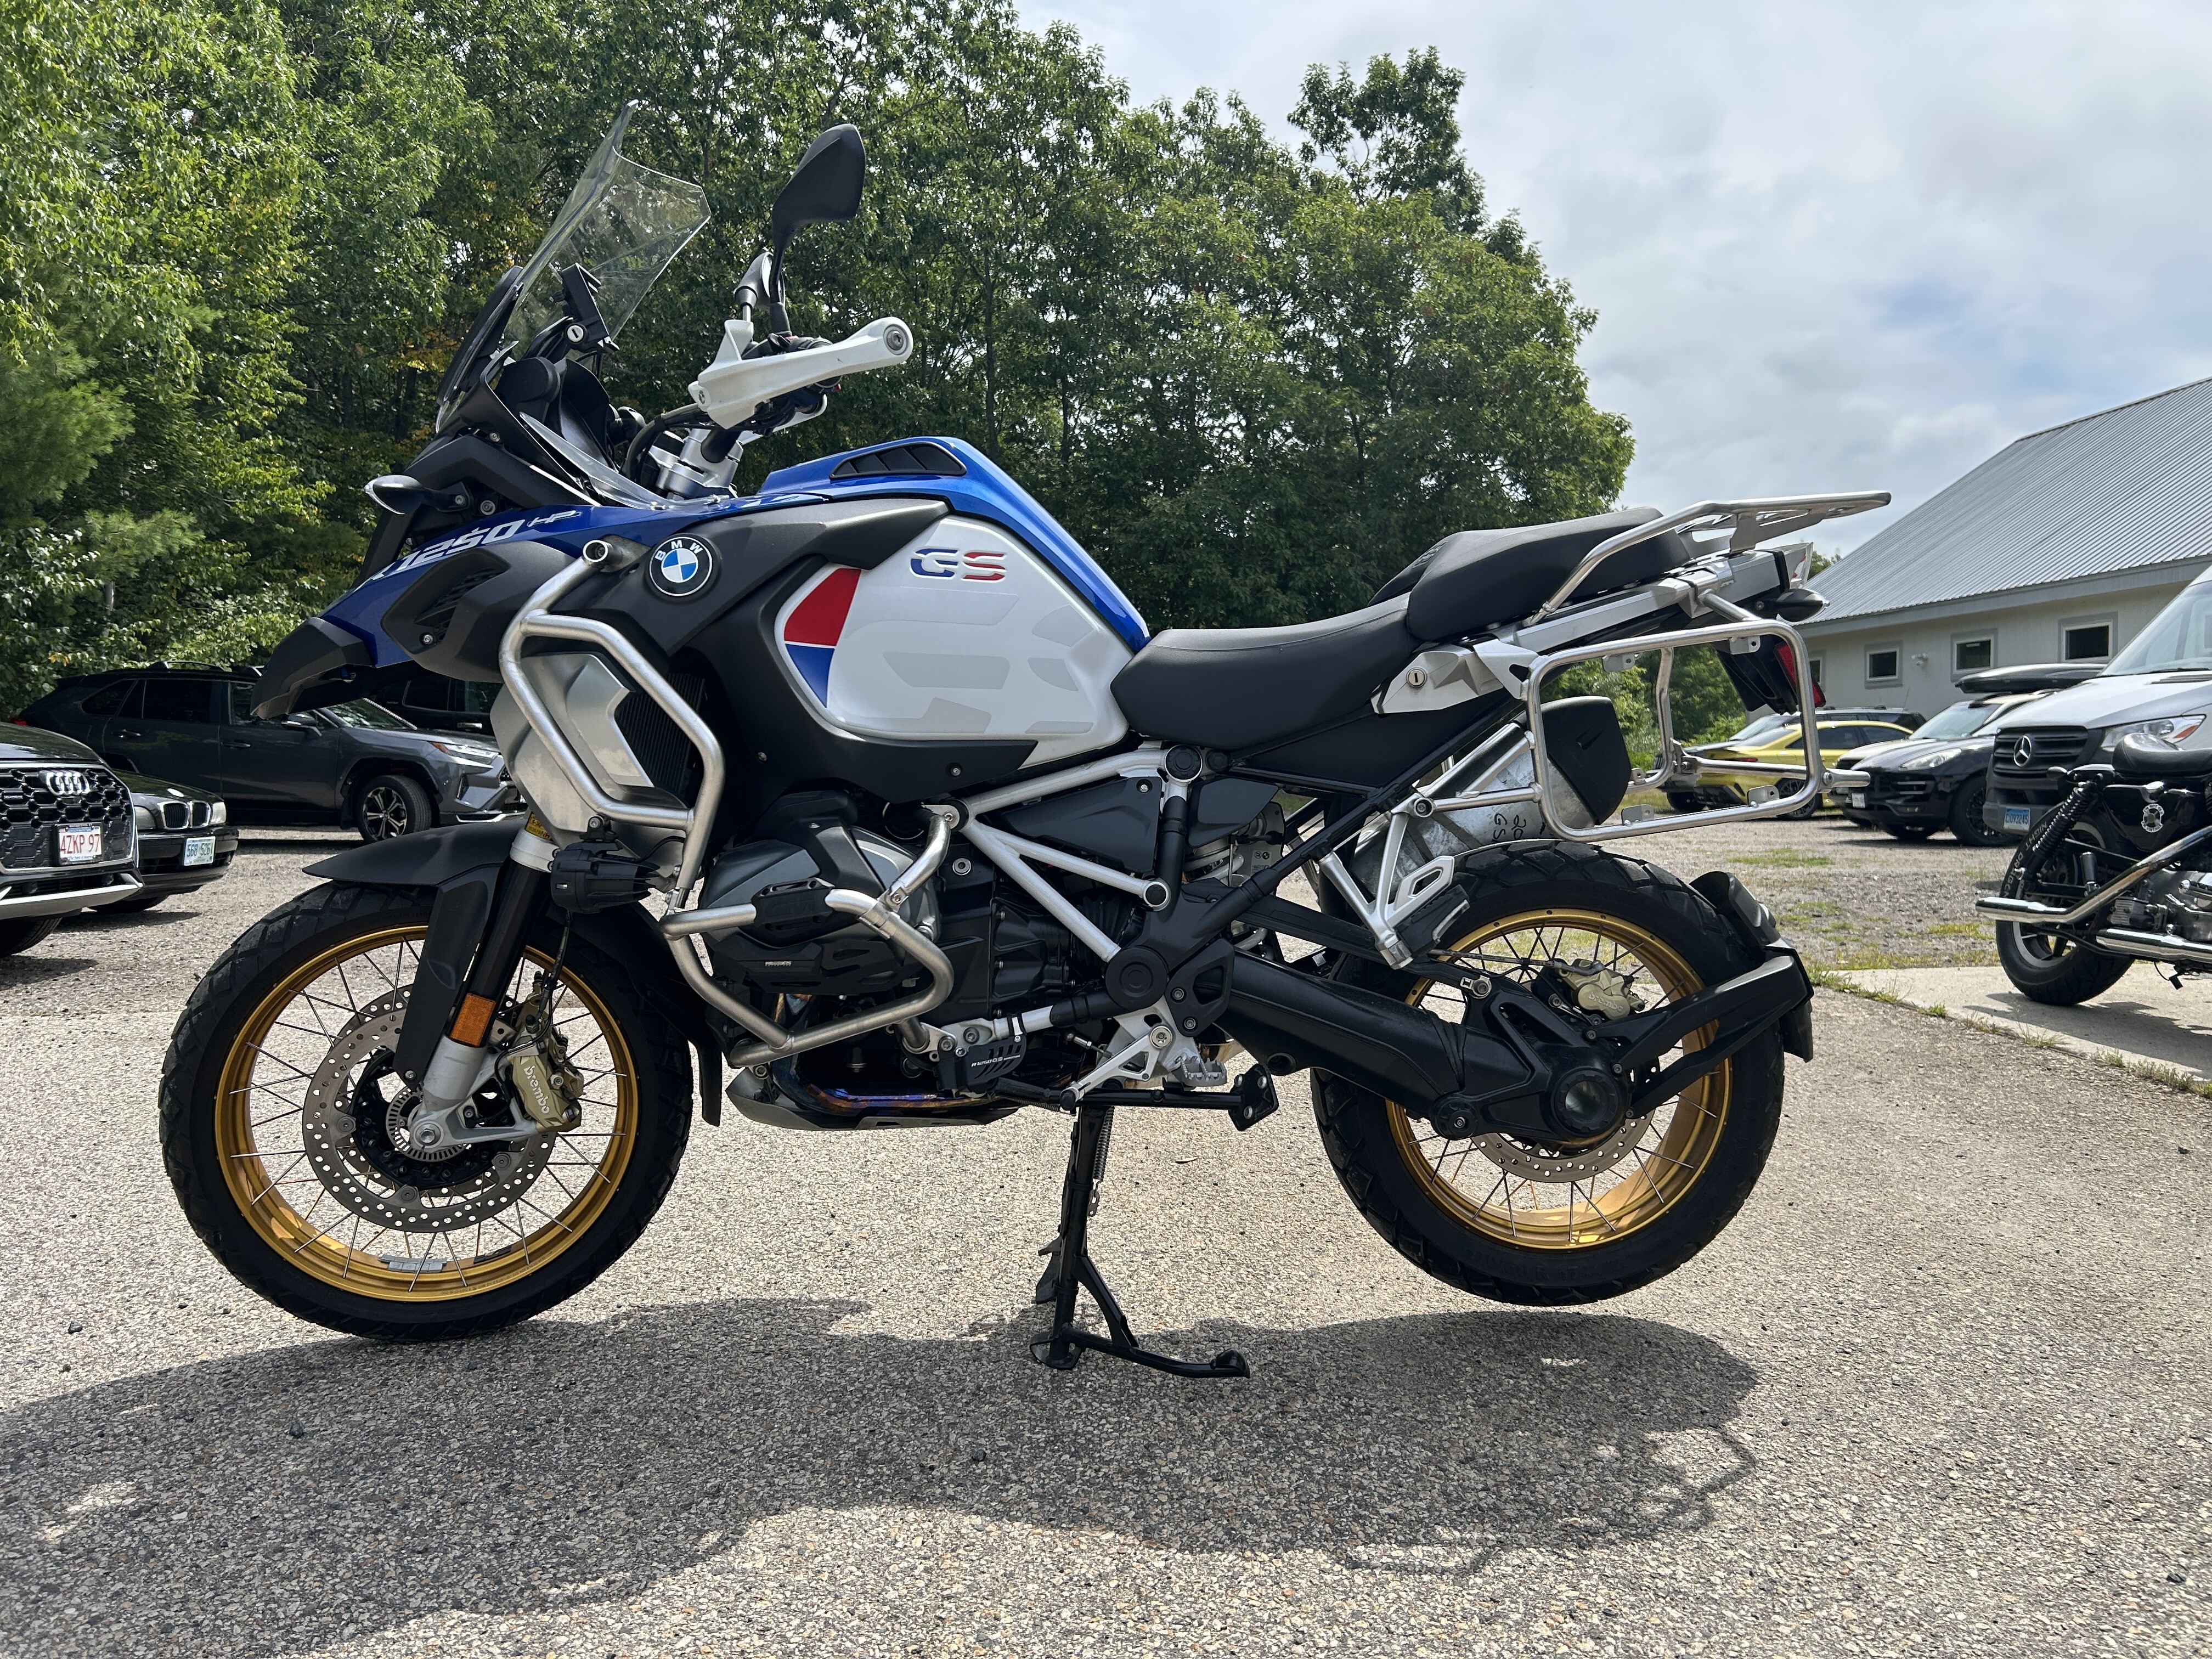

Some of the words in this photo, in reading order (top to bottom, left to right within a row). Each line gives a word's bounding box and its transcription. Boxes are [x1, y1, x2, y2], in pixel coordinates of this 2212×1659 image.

[397, 519, 526, 571] 1250
[654, 540, 703, 561] BMW
[909, 546, 1008, 583] GS
[59, 834, 85, 854] 4ZKP
[88, 833, 100, 853] 97
[2025, 821, 2047, 850] NIGHT
[1588, 991, 1624, 1013] brembo
[523, 1065, 550, 1114] brembo
